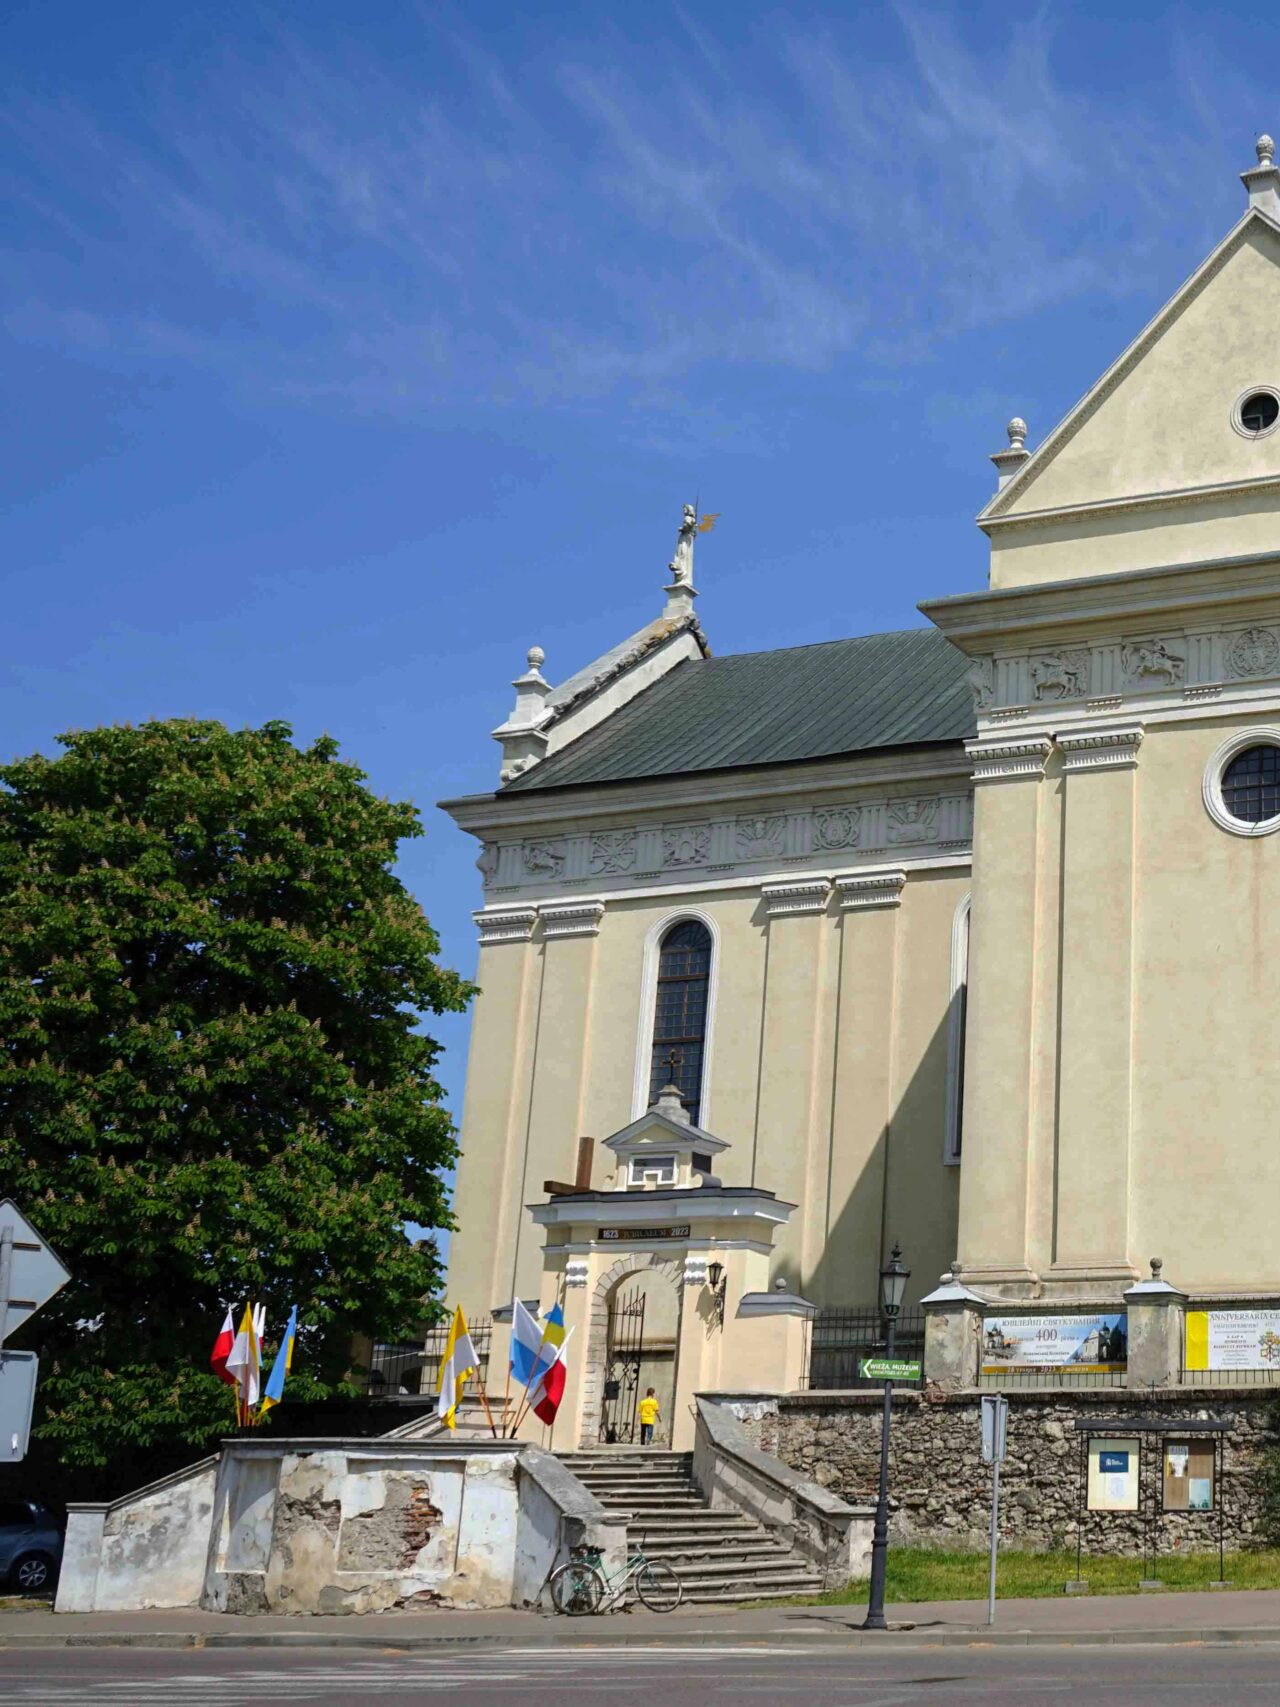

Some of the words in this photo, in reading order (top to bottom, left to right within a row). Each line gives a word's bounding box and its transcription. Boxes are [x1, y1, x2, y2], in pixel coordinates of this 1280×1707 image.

[671, 1226, 689, 1236] 2023
[1036, 1328, 1058, 1341] 400
[892, 1363, 919, 1371] MUZEUM
